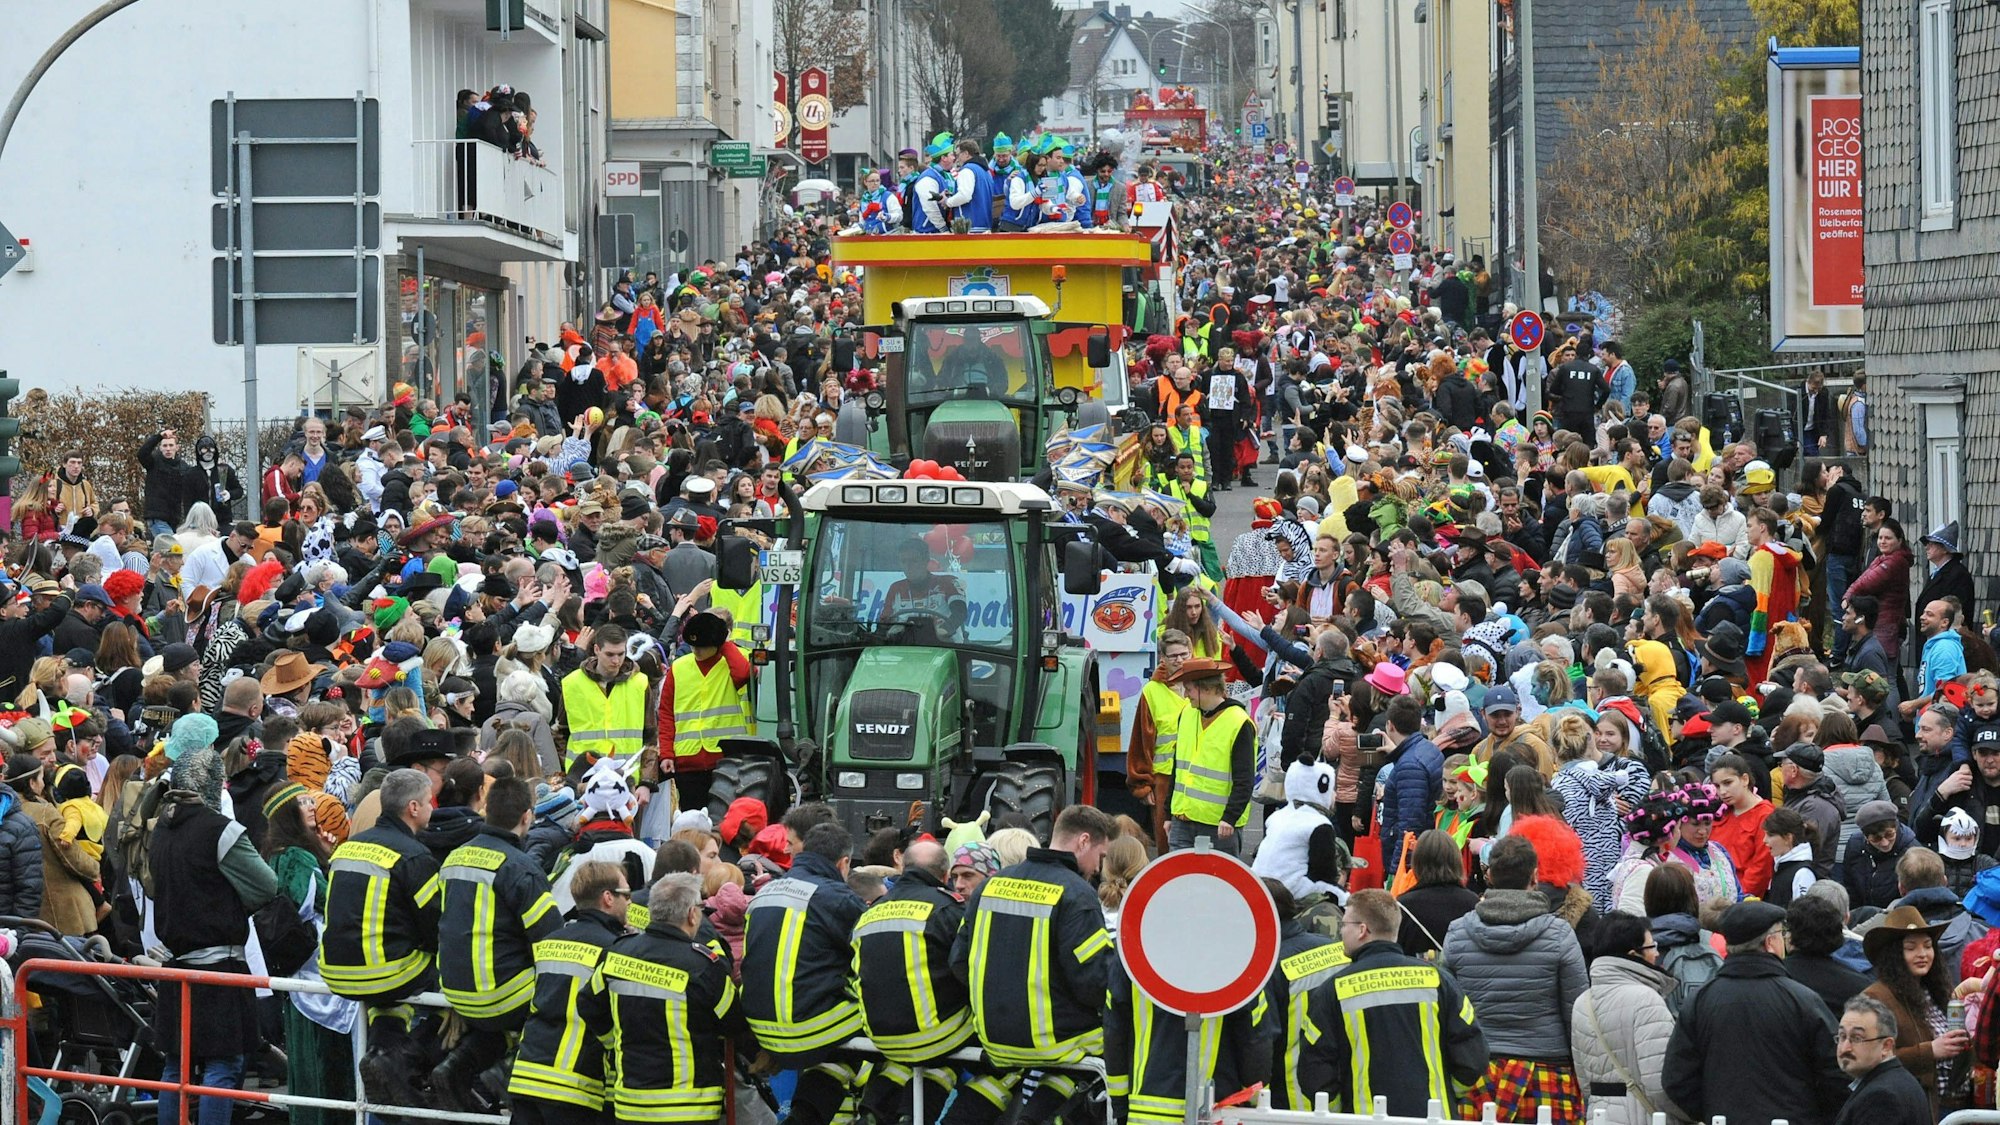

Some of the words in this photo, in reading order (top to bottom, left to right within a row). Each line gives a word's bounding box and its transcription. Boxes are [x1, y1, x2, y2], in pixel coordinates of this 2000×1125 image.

[1818, 137, 1861, 156] GEÖ
[1819, 160, 1856, 177] HIER
[607, 173, 639, 186] SPD
[1819, 180, 1851, 197] WIR
[1819, 207, 1862, 216] Rosenmon
[1820, 230, 1859, 239] geöffnet.
[1570, 371, 1591, 380] FBI
[769, 553, 787, 567] GL
[761, 568, 780, 582] VS
[783, 568, 800, 582] 63
[1107, 587, 1138, 598] ELK
[855, 723, 910, 735] FENDT
[1977, 730, 1997, 742] FBI
[990, 880, 1060, 895] FEUERWEHR
[994, 887, 1047, 901] LEICHLINGEN
[1283, 945, 1343, 969] FEUERWEHR
[609, 955, 685, 981] FEUERWEHR
[1296, 955, 1342, 975] LEICHLINGEN
[613, 966, 672, 987] LEICHLINGEN
[1339, 969, 1434, 988] FEUERWEHR
[1353, 978, 1424, 993] LEICHLINGEN
